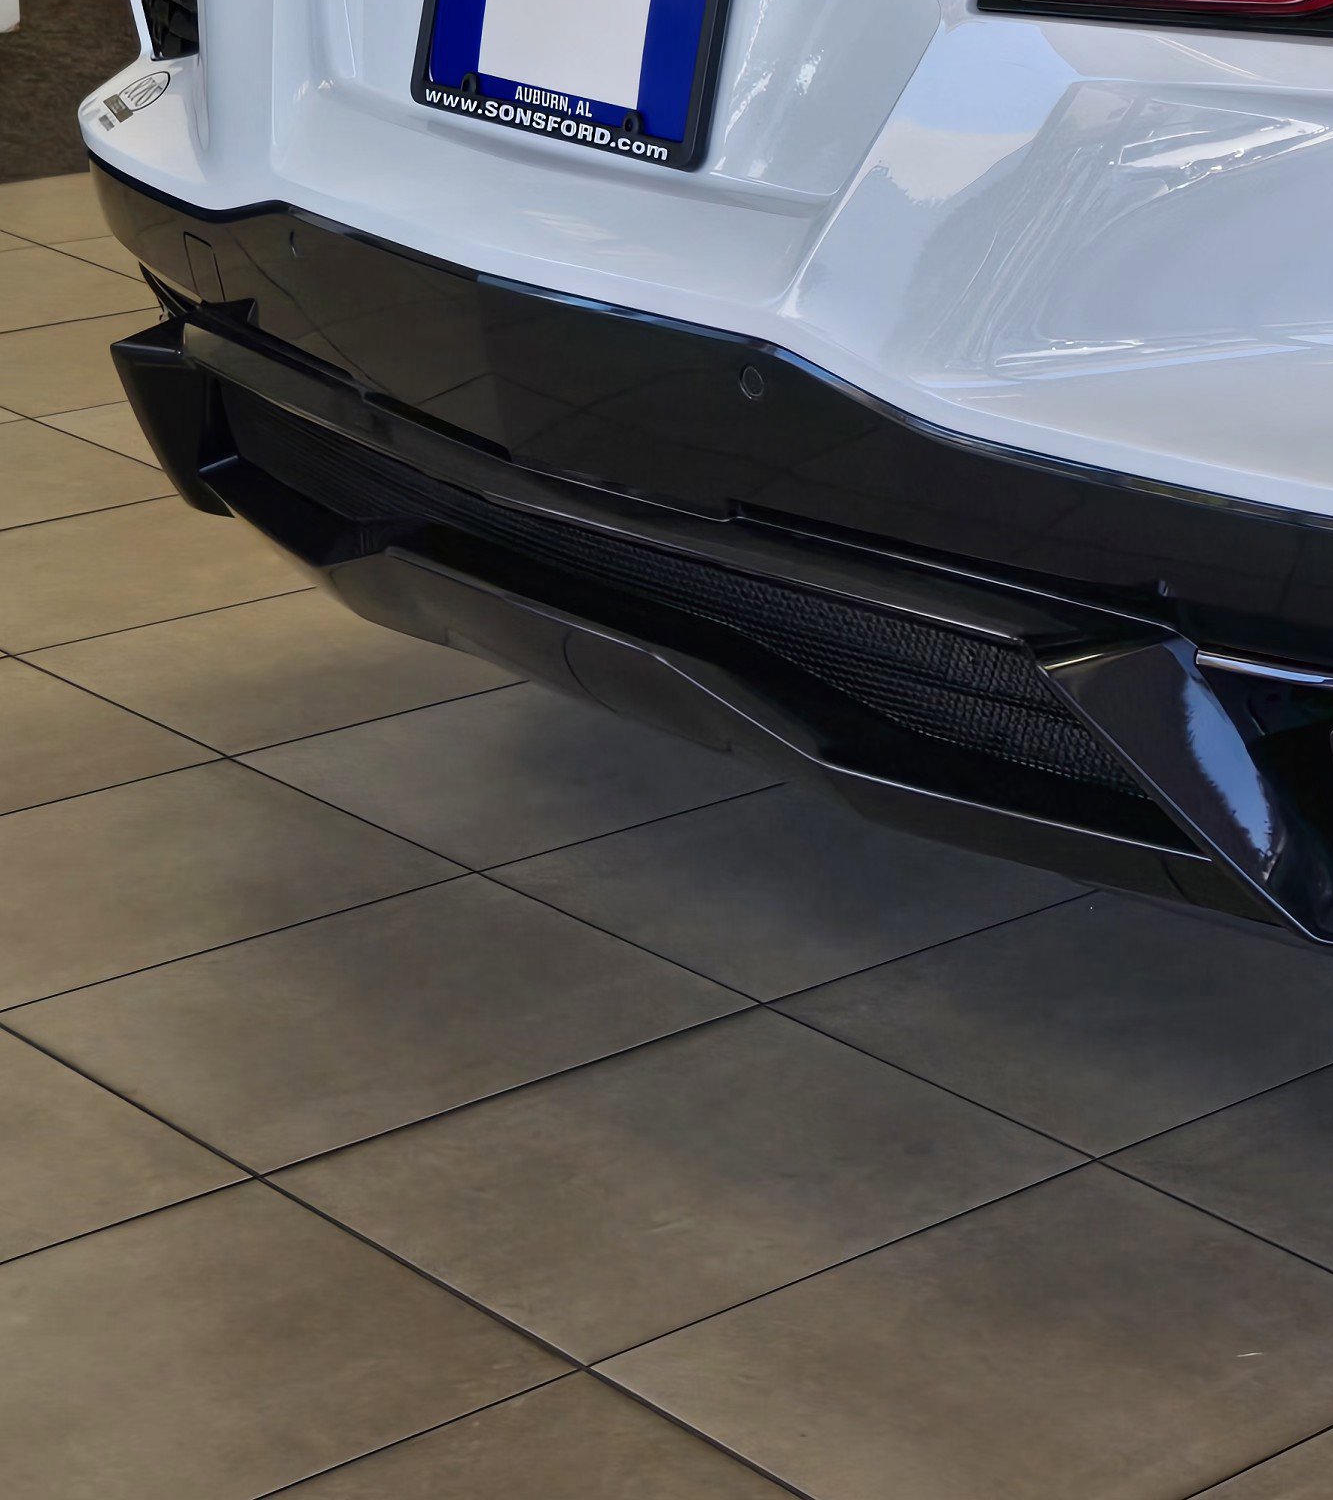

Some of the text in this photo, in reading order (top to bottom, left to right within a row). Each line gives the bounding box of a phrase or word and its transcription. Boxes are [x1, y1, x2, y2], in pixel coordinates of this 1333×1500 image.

[425, 89, 668, 160] www.SONSFORD.com
[514, 86, 593, 117] AUBURN, AL
